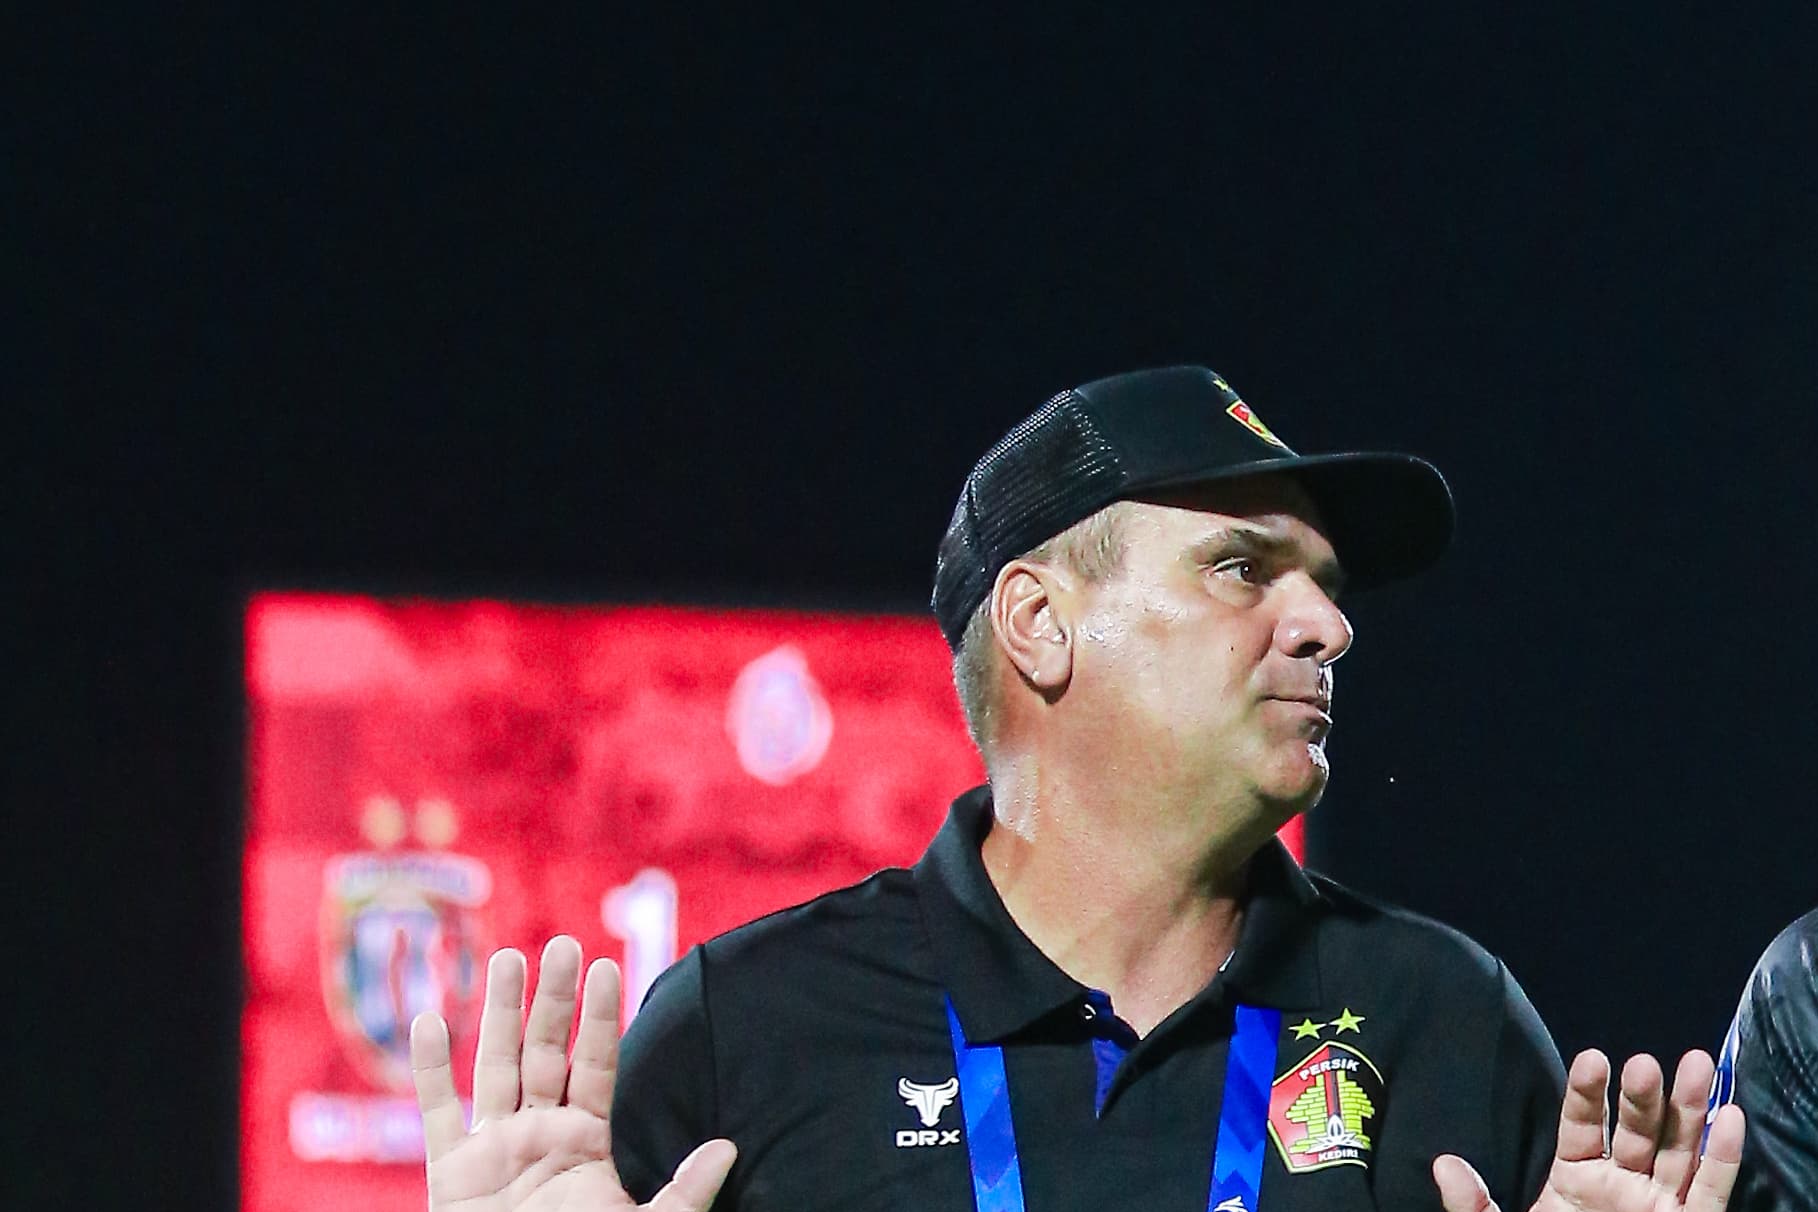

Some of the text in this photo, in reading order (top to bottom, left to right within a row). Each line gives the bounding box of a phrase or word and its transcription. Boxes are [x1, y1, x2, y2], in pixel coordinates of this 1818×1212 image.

[602, 868, 678, 1030] 1
[1299, 1058, 1360, 1081] PERSIK
[896, 1129, 961, 1147] DRX
[1318, 1148, 1358, 1161] KEDIRI
